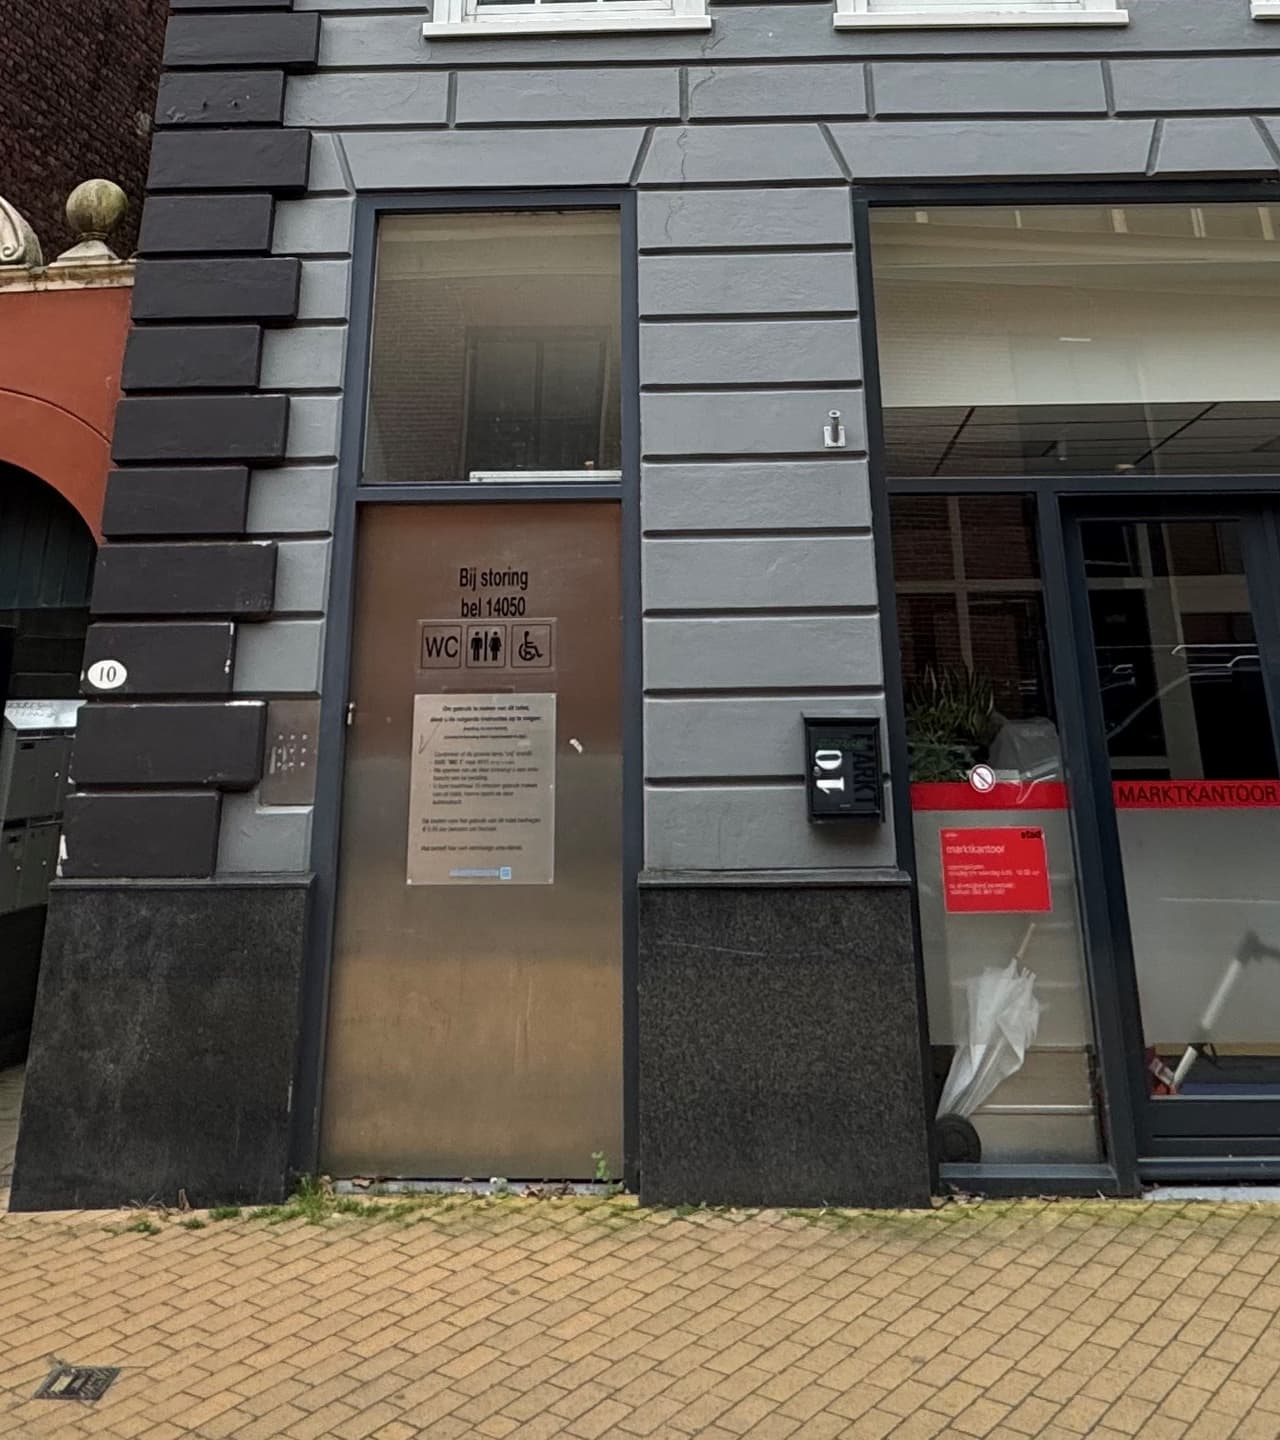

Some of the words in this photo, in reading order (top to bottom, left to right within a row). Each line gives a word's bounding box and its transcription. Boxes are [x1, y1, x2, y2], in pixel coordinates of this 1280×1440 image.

[459, 566, 477, 591] Bij
[480, 565, 529, 591] storing
[461, 597, 481, 617] bel
[486, 596, 526, 617] 14050
[425, 635, 459, 658] WC
[99, 666, 117, 682] 10
[814, 750, 845, 795] 10
[1119, 783, 1278, 803] MARKTKANTOOR
